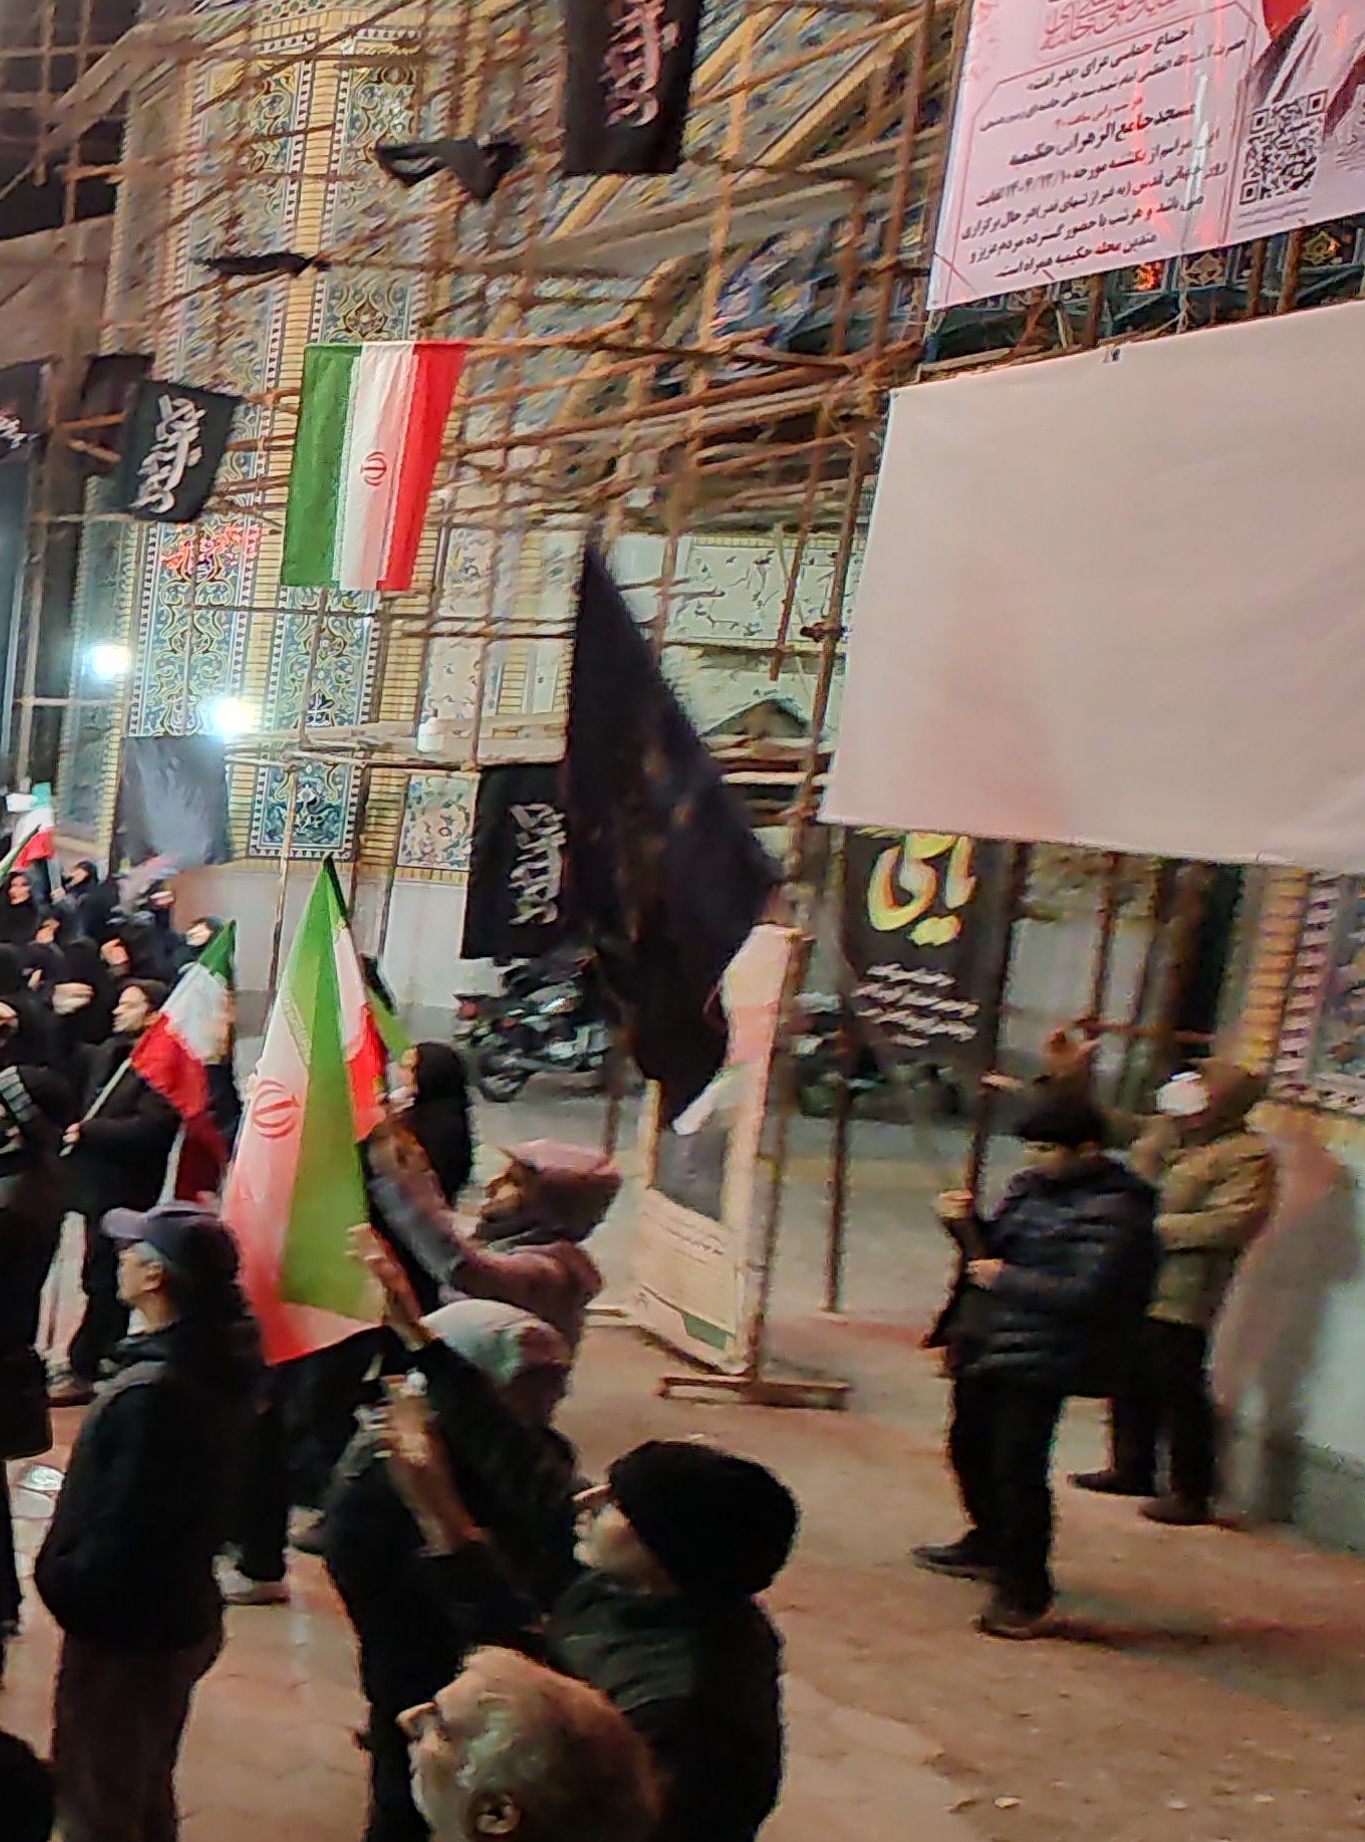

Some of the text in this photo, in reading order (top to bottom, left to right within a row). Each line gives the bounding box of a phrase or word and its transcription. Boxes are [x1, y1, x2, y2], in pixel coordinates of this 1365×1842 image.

[1152, 103, 1195, 126] مسجد
[1114, 111, 1154, 142] جامع
[1143, 207, 1153, 221] و
[1062, 220, 1097, 241] حضور
